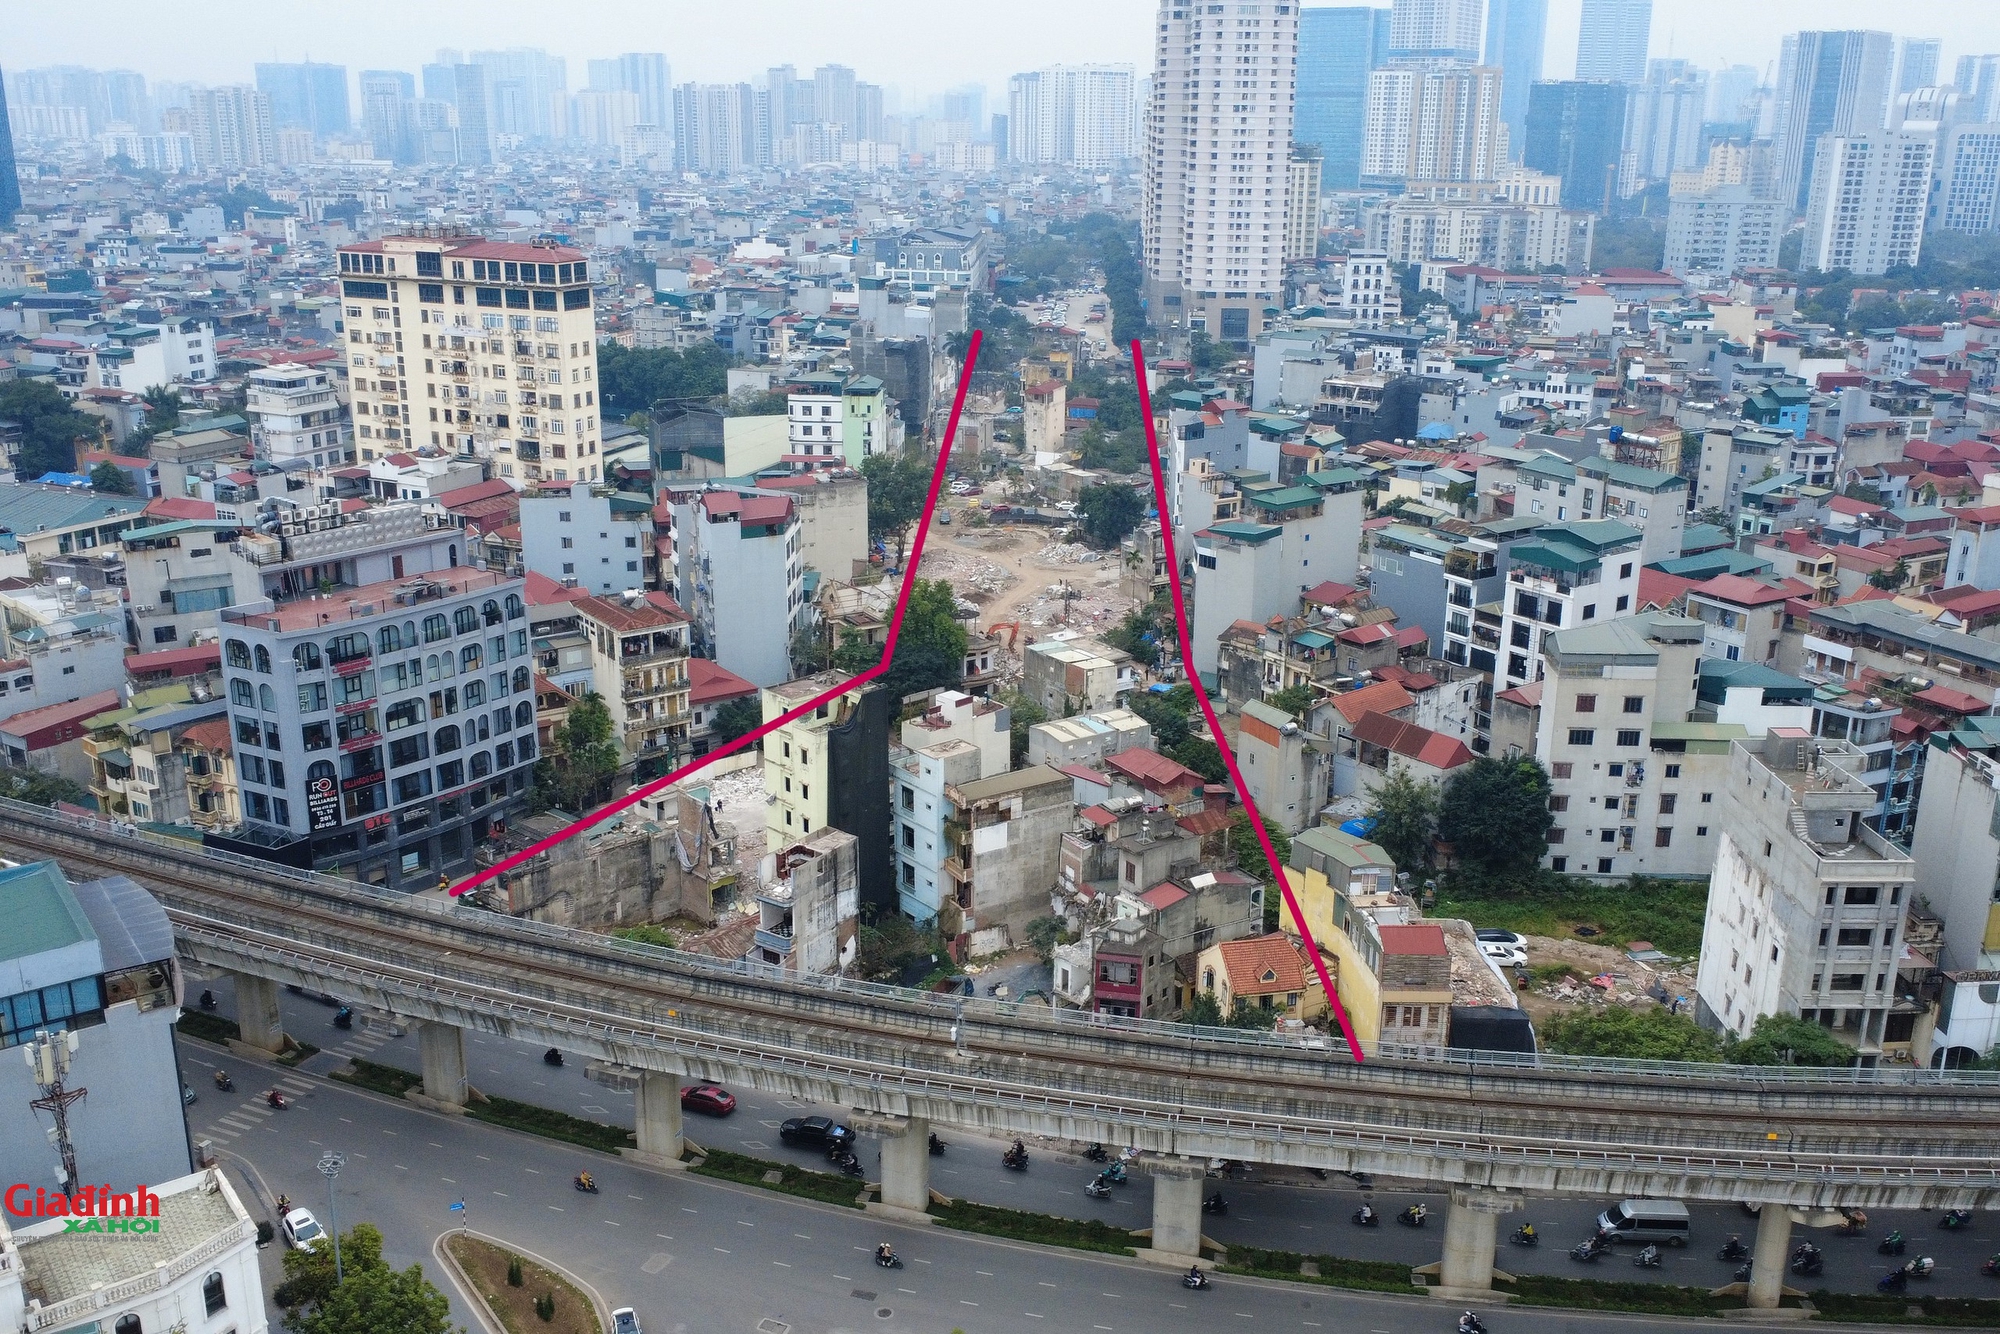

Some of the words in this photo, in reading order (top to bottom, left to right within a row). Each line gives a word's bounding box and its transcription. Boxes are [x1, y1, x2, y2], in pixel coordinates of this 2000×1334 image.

[308, 793, 323, 801] RUN
[323, 790, 337, 798] OUT
[309, 796, 338, 806] BILLIARDS
[1957, 970, 2000, 981] GERM
